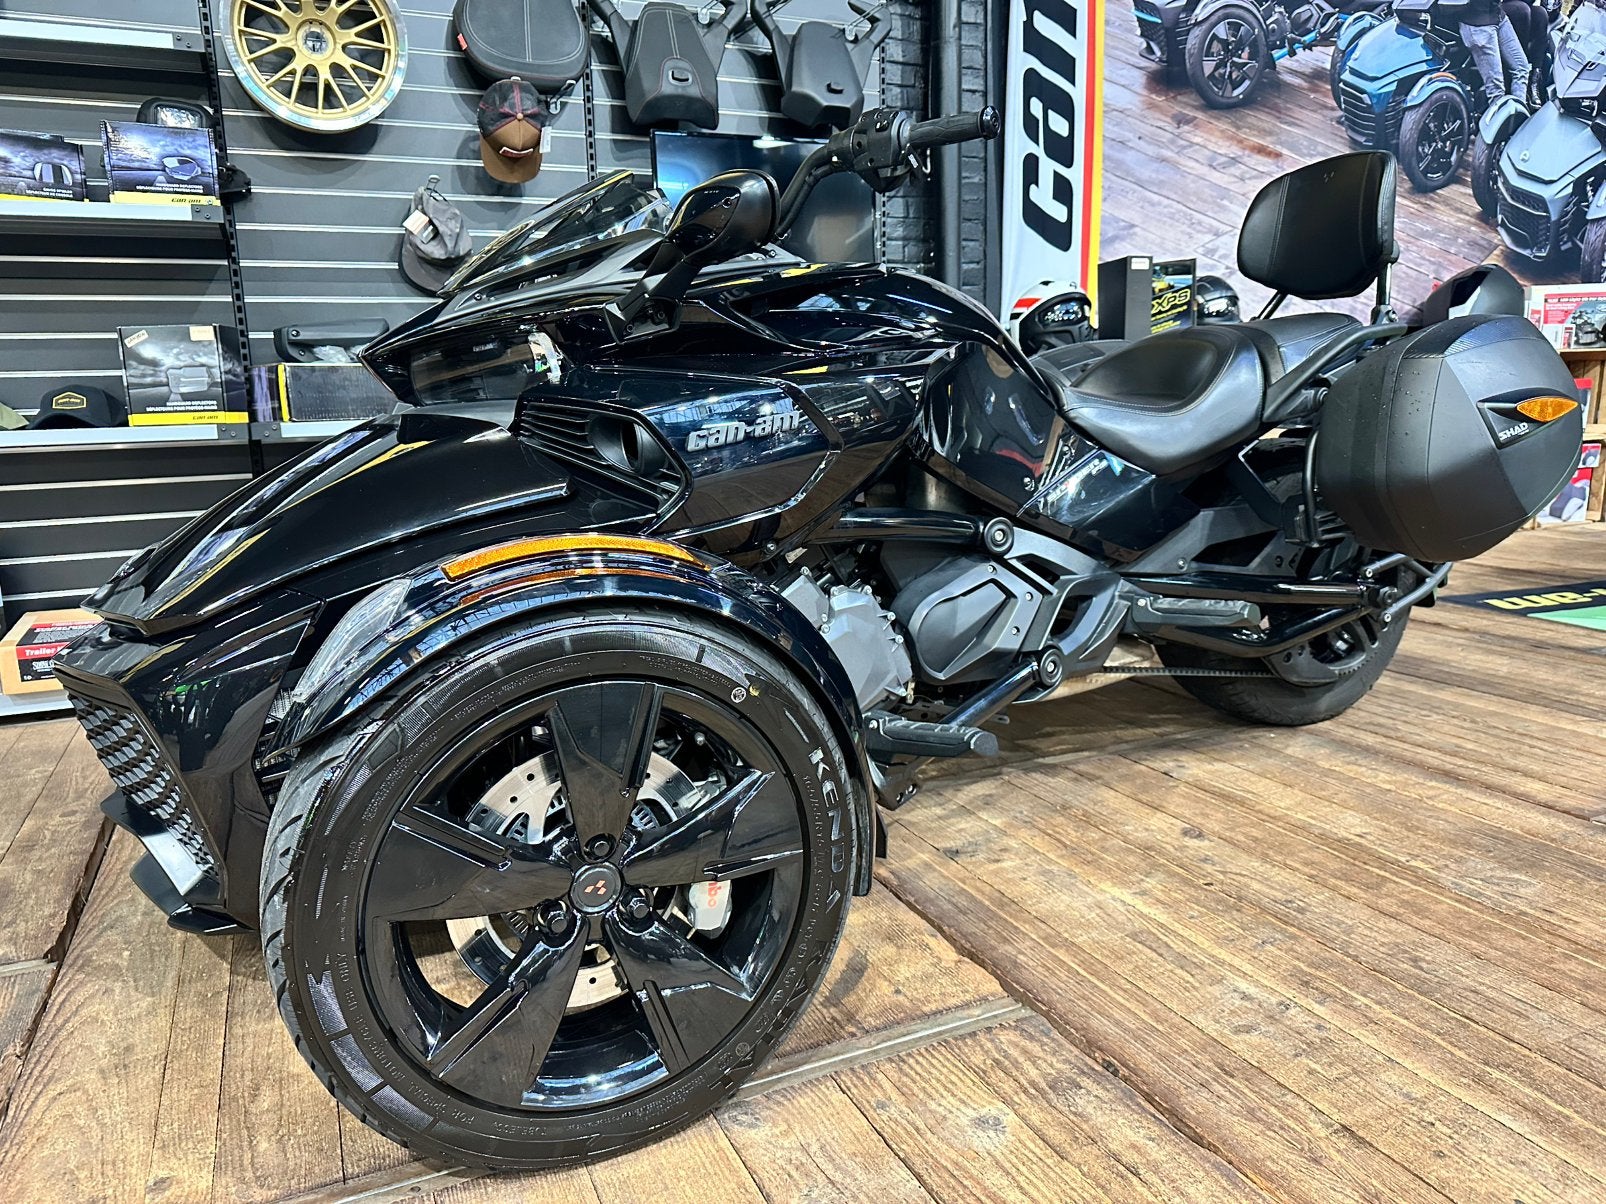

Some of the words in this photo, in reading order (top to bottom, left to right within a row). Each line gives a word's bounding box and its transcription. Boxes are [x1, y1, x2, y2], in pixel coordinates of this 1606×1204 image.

[1151, 288, 1191, 314] XPS
[686, 410, 800, 453] can-am
[1498, 421, 1529, 441] SHAD
[25, 647, 56, 657] Trailer
[808, 746, 845, 914] KENDA
